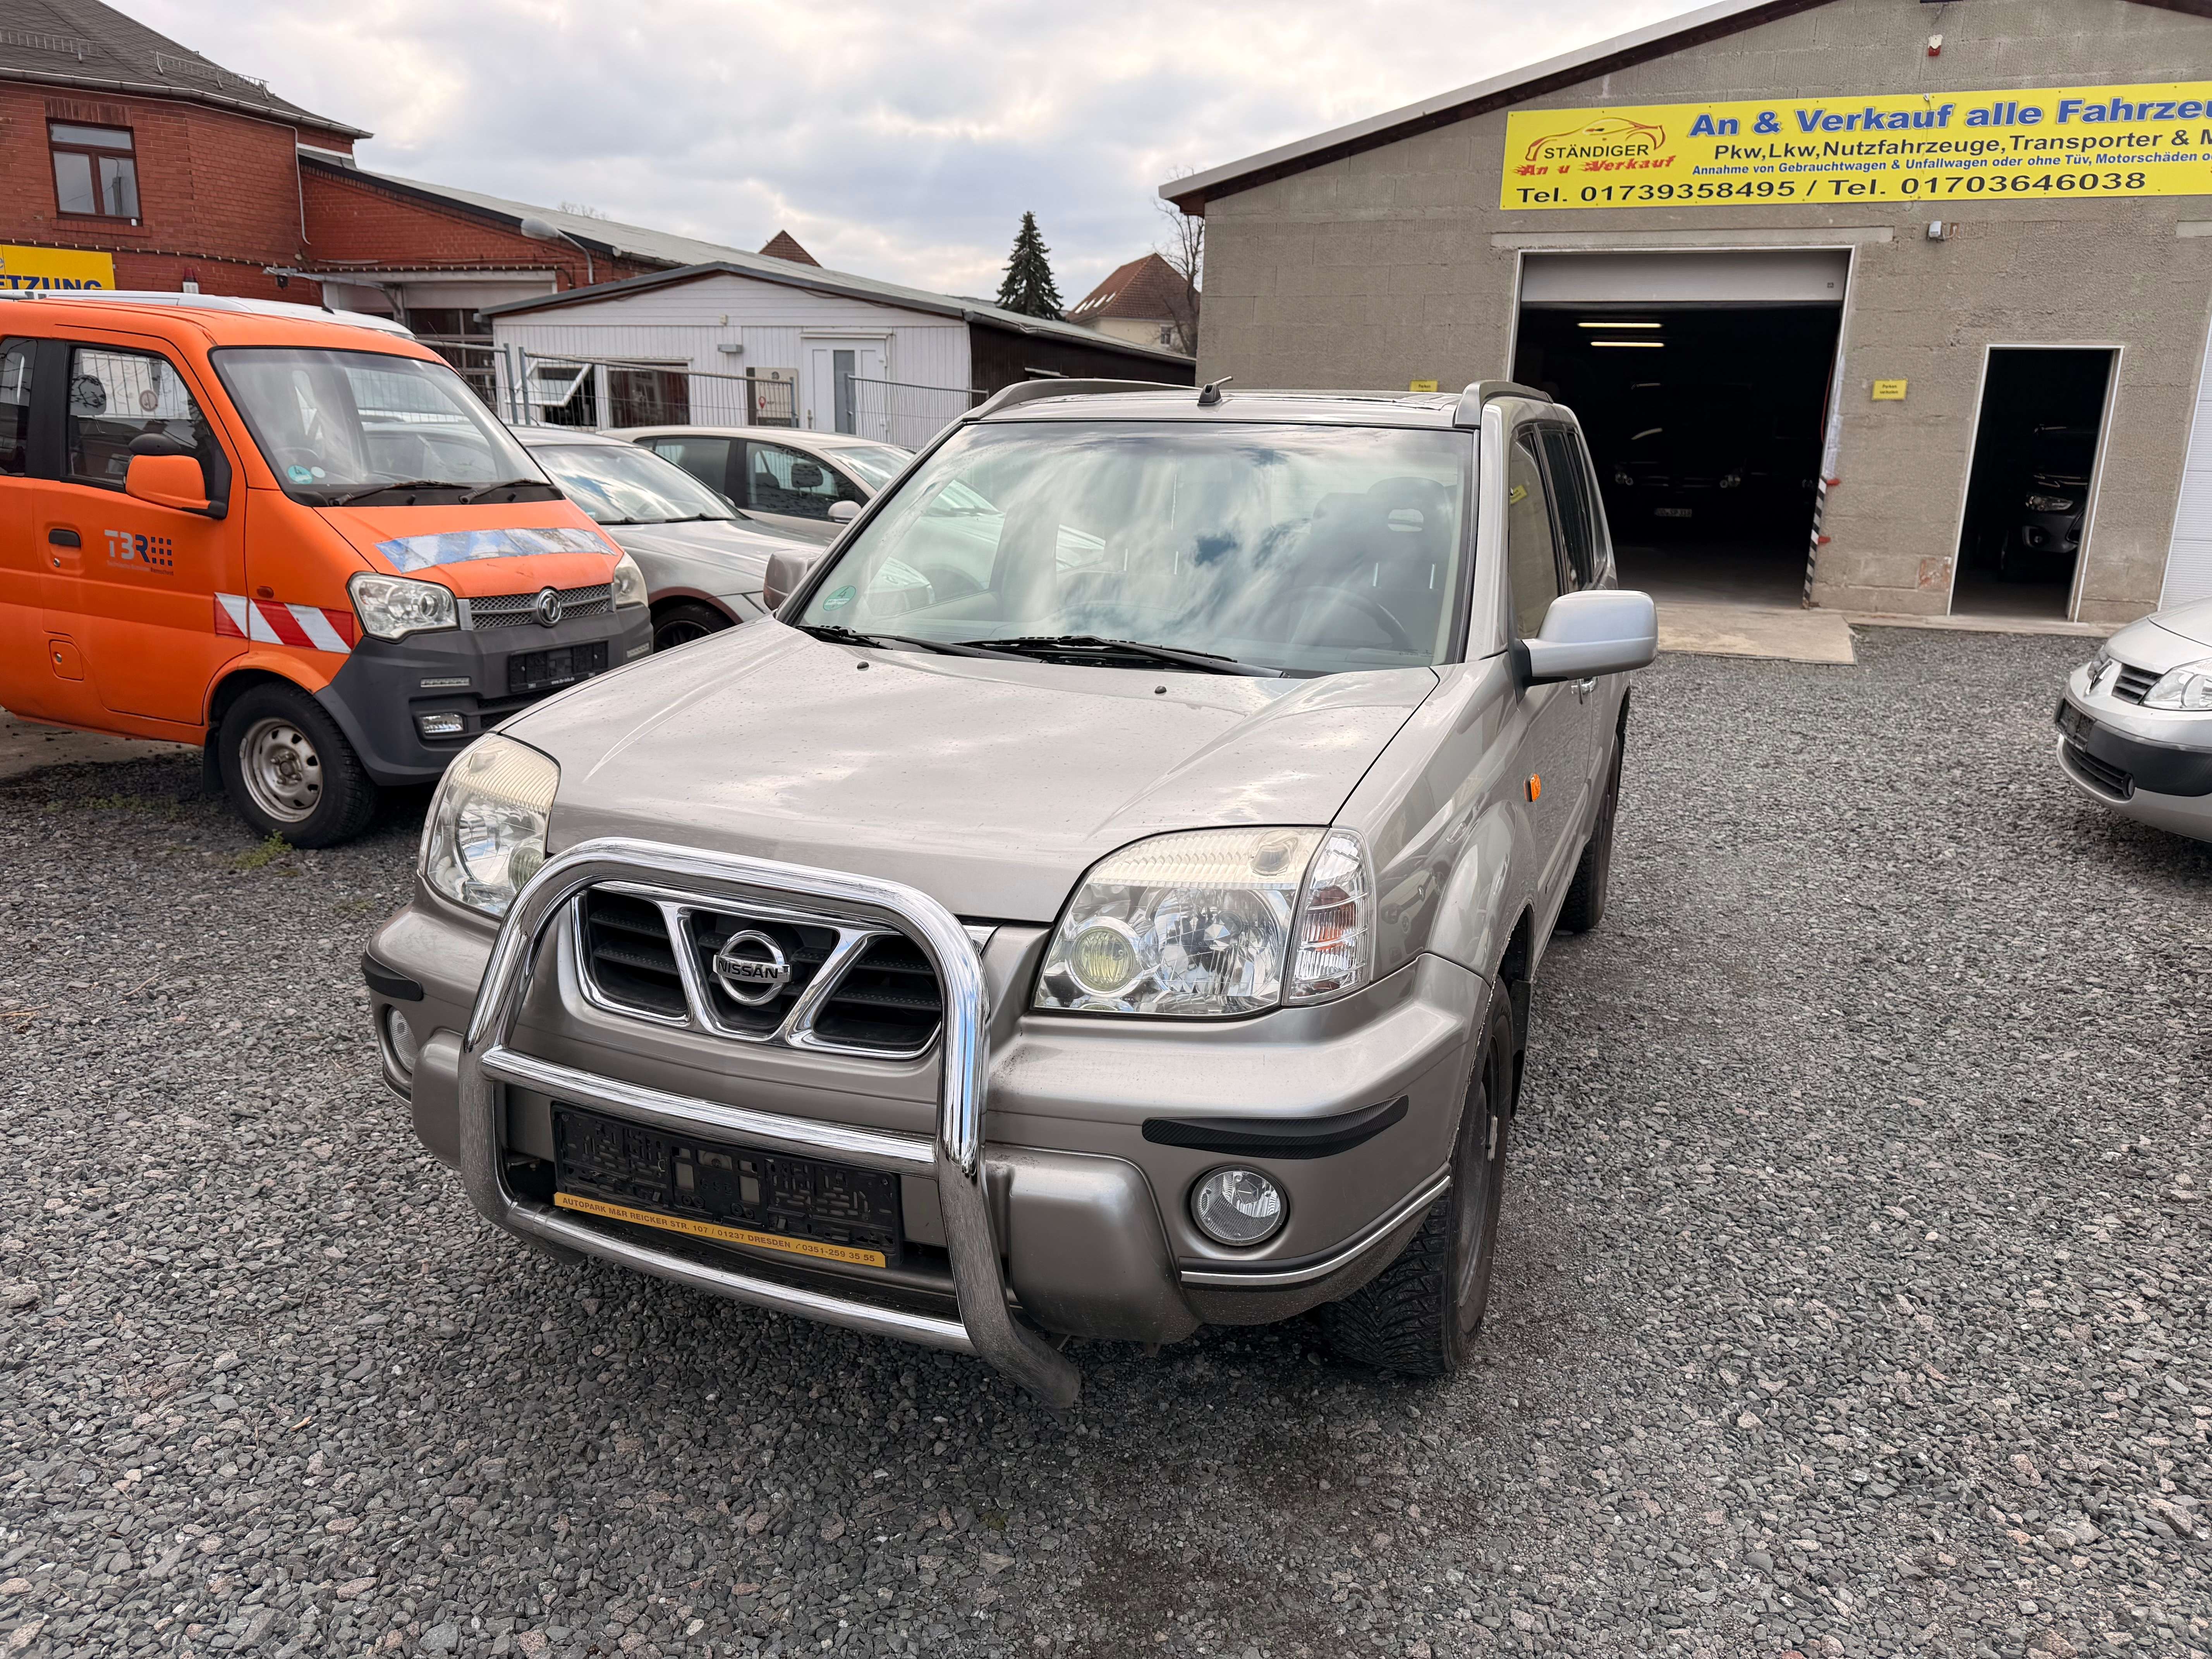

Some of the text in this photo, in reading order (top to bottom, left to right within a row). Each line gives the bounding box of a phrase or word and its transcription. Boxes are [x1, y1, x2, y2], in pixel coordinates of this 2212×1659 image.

[1690, 114, 1738, 137] An
[1753, 112, 1780, 134] &
[1796, 104, 1954, 132] Verkauf
[1966, 102, 2042, 126] alle
[2171, 130, 2189, 146] &
[1544, 144, 1649, 159] STÄNDIGER
[1515, 164, 1548, 176] An
[1583, 155, 1675, 172] Verkauf
[1693, 165, 1748, 174] Annahme
[1779, 160, 1886, 172] Gebrauchtwagen
[1891, 160, 1900, 169] &
[1906, 158, 1987, 170] Unfallwagen
[1992, 156, 2023, 166] oder
[2028, 156, 2061, 165] ohne
[2065, 155, 2092, 165] Tüv,
[2096, 151, 2197, 163] Motorschäden
[1516, 173, 2146, 203] Tel. 01739358495 / Tel. 01703646038
[837, 587, 849, 598] 4
[718, 960, 778, 979] NISSAN
[563, 1197, 606, 1213] AUTOPARK
[608, 1207, 628, 1218] M&R
[630, 1212, 668, 1226] REICKER
[670, 1220, 690, 1230] STR.
[693, 1224, 708, 1233] 107
[718, 1229, 745, 1240] 01237
[747, 1235, 791, 1248] DRESDEN
[802, 1244, 846, 1257] 0351-259
[848, 1252, 860, 1260] 35
[863, 1253, 875, 1262] 55
